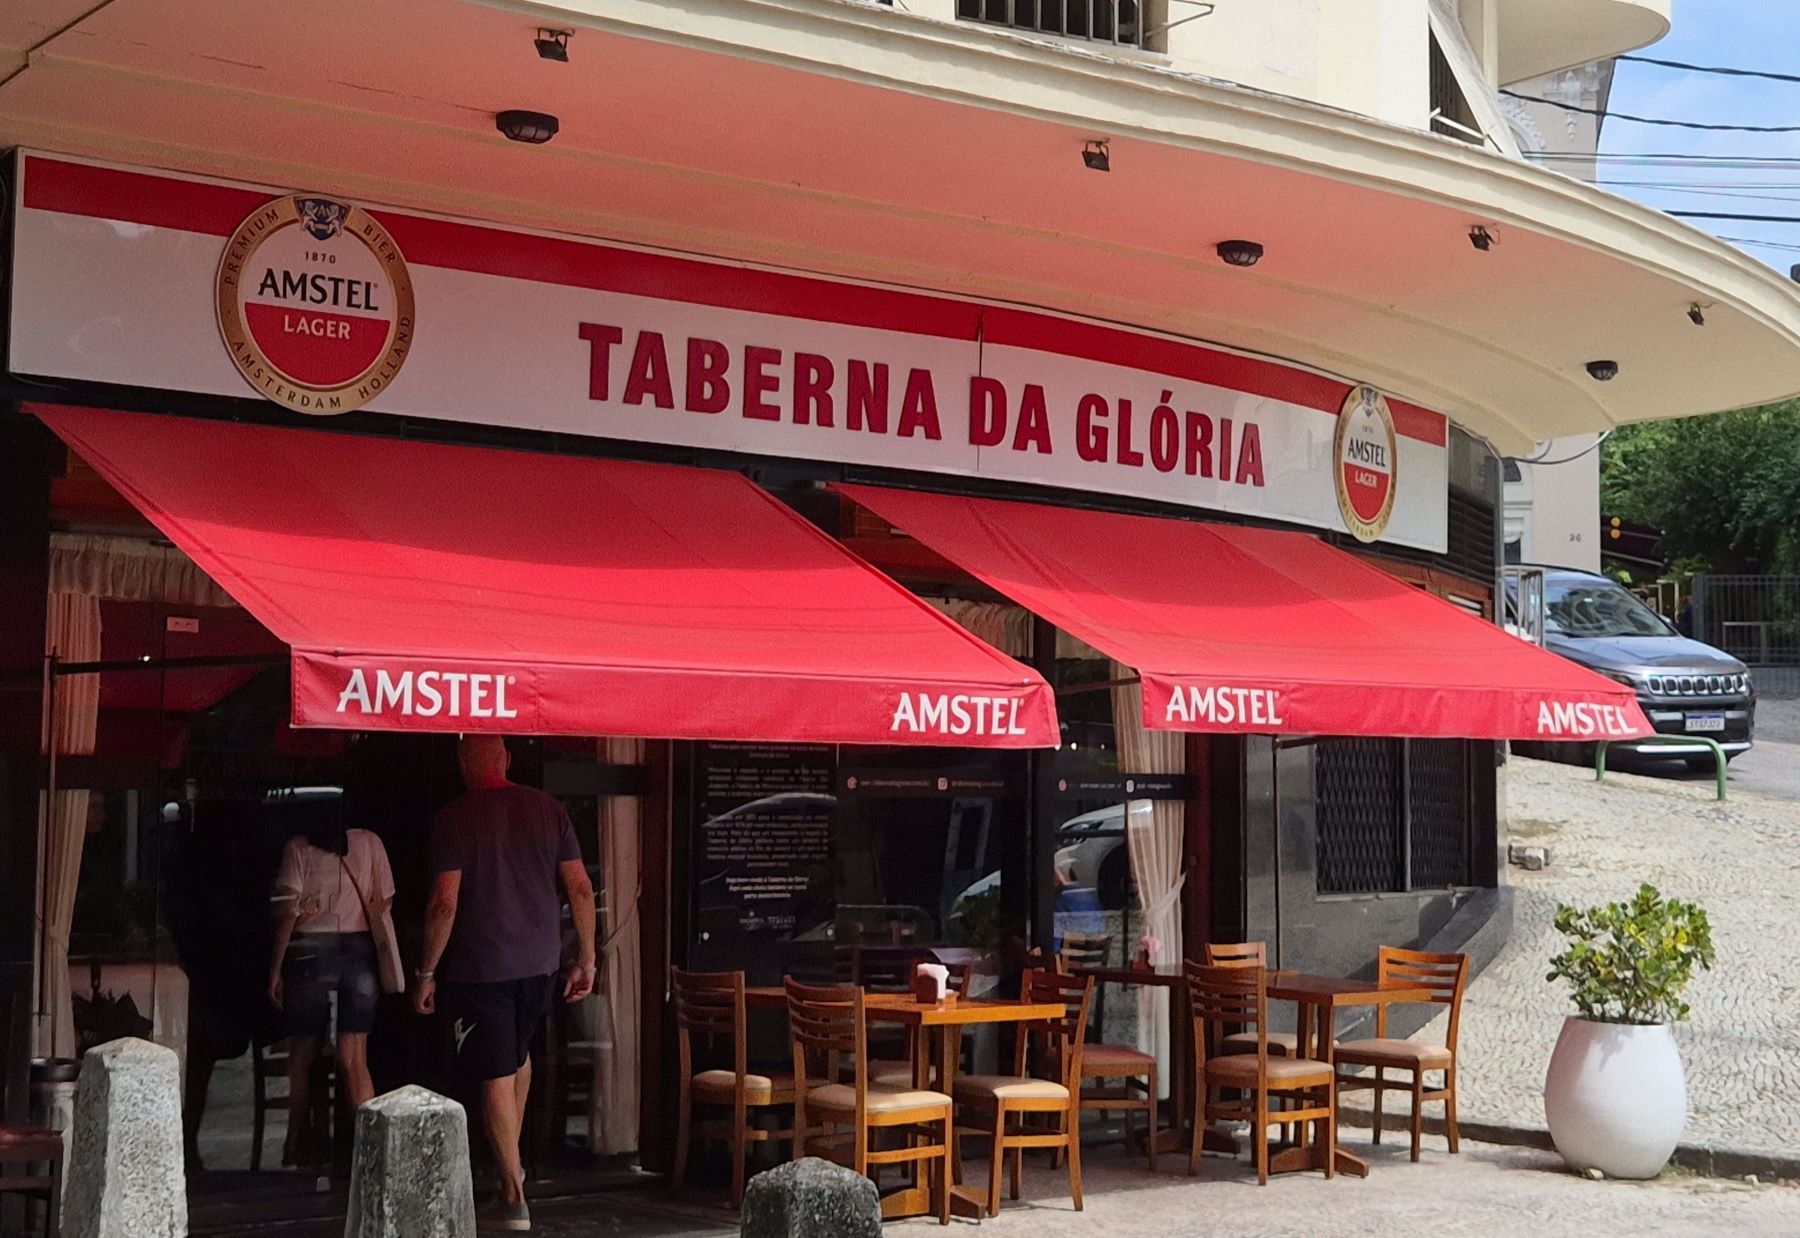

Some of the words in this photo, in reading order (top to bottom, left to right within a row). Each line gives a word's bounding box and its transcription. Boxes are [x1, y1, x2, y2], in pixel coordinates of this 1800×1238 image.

[225, 208, 280, 286] PREMIUM
[363, 224, 397, 264] BIER
[304, 251, 336, 265] 1870
[258, 267, 379, 311] AMSTEL
[284, 314, 351, 340] LAGER
[233, 340, 342, 410] AMSTERDAM
[358, 316, 412, 400] HOLLAND
[579, 321, 943, 441] TABERNA
[969, 376, 1053, 455] DA
[1076, 389, 1265, 487] GLÓRIA
[1348, 437, 1386, 467] AMSTEL
[1355, 470, 1378, 488] LAGER
[336, 668, 518, 718] AMSTEL
[890, 692, 1026, 735] AMSTEL
[1166, 685, 1283, 725] AMSTEL
[1537, 700, 1639, 735] AMSTEL
